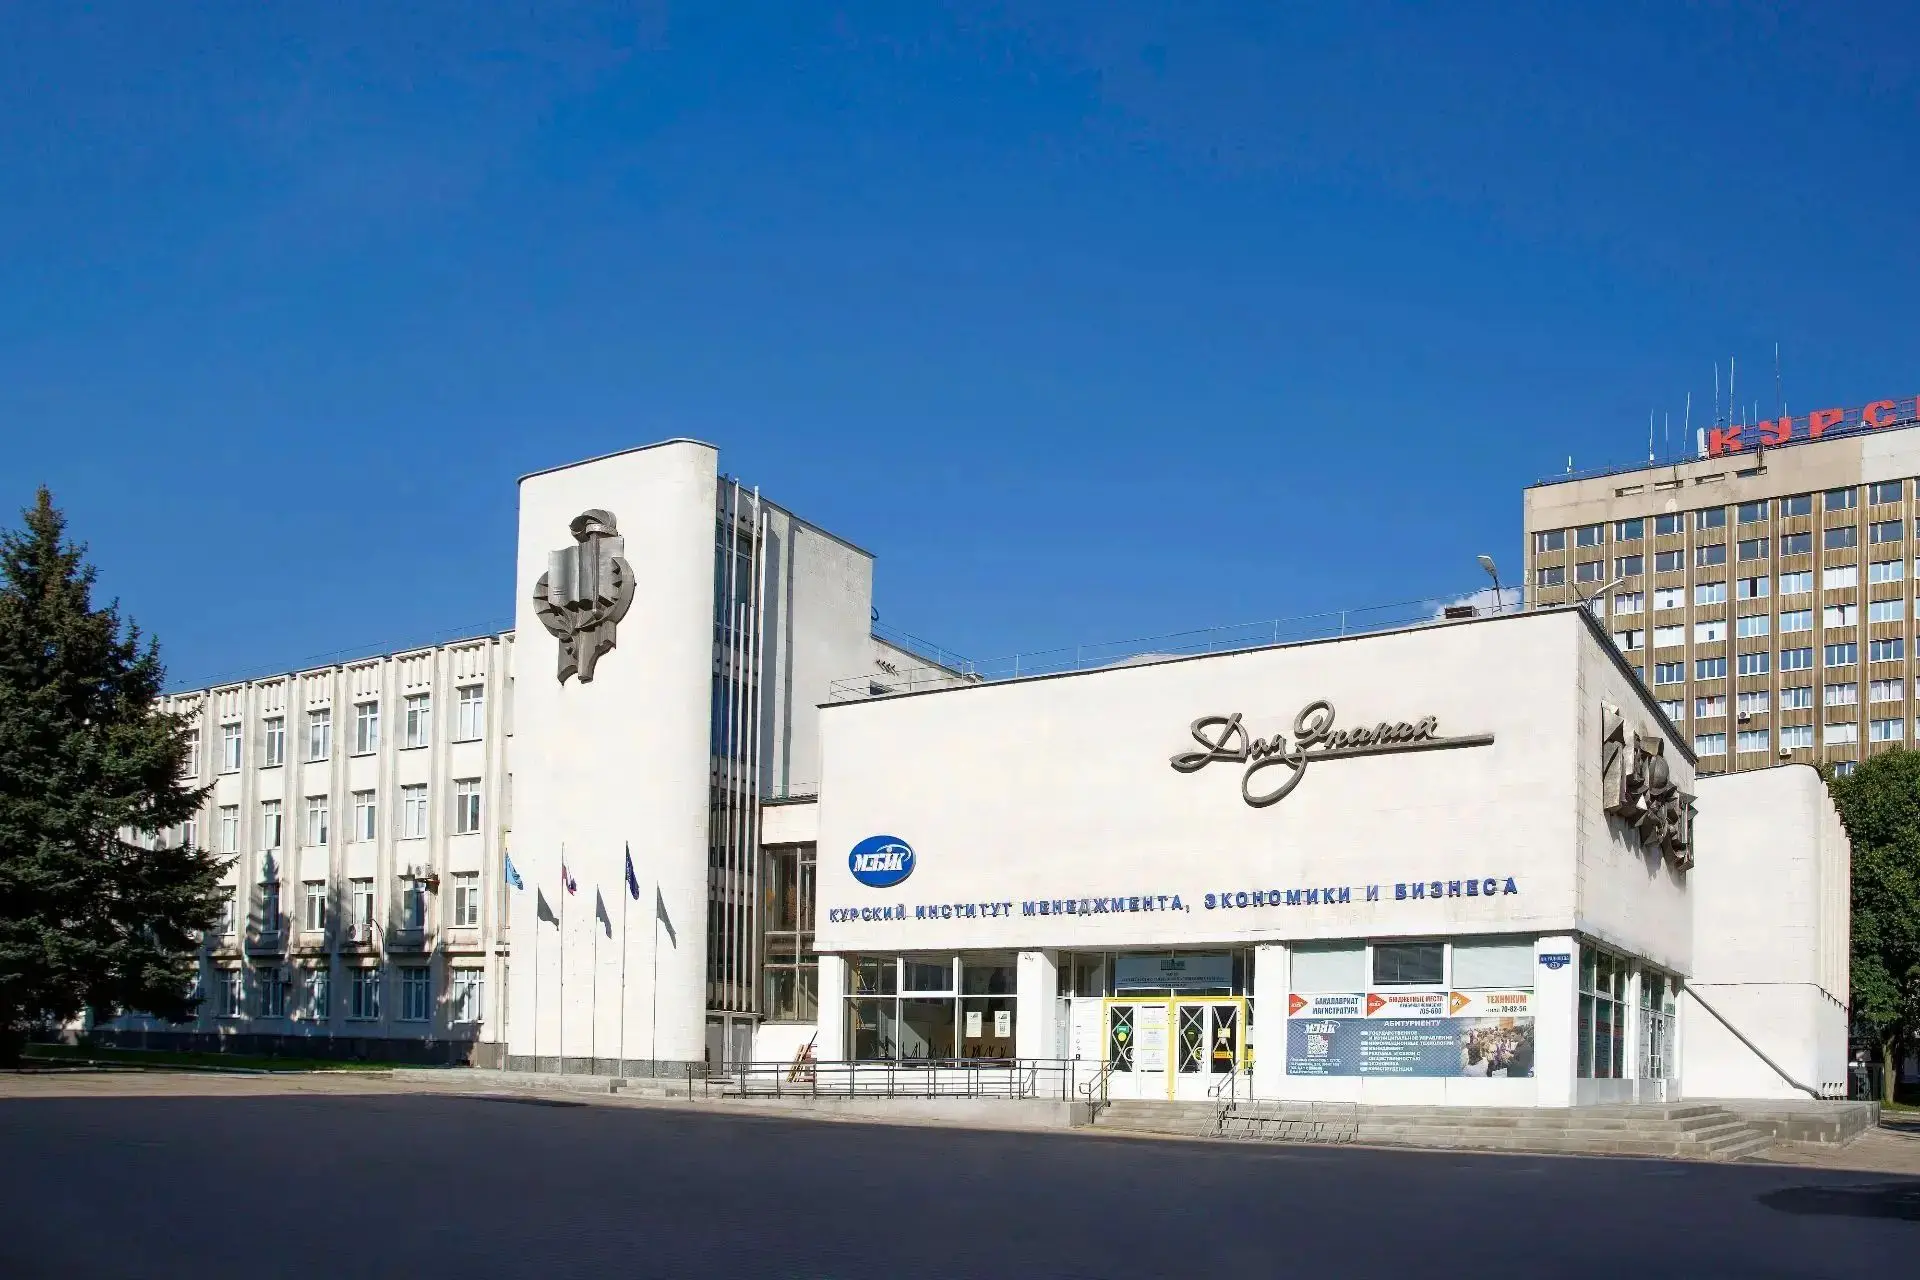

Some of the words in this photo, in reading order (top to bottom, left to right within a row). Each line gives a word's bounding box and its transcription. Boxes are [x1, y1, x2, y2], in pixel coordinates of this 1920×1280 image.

[1708, 396, 1920, 459] КУРС
[829, 903, 906, 922] КУРСКИЙ
[916, 902, 1012, 920] ИНСТИТУТ
[1023, 894, 1191, 916] МЕНЕДЖМЕНТА,
[1204, 885, 1351, 910] ЭКОНОМИКИ
[1366, 885, 1379, 901] И
[1395, 877, 1518, 900] БИЗНЕСА
[1315, 997, 1359, 1005] БАКАЛАВРИАТ
[1486, 994, 1527, 1004] ТЕХНИКУМ
[1313, 1006, 1359, 1015] МАГИСТРАТУРА
